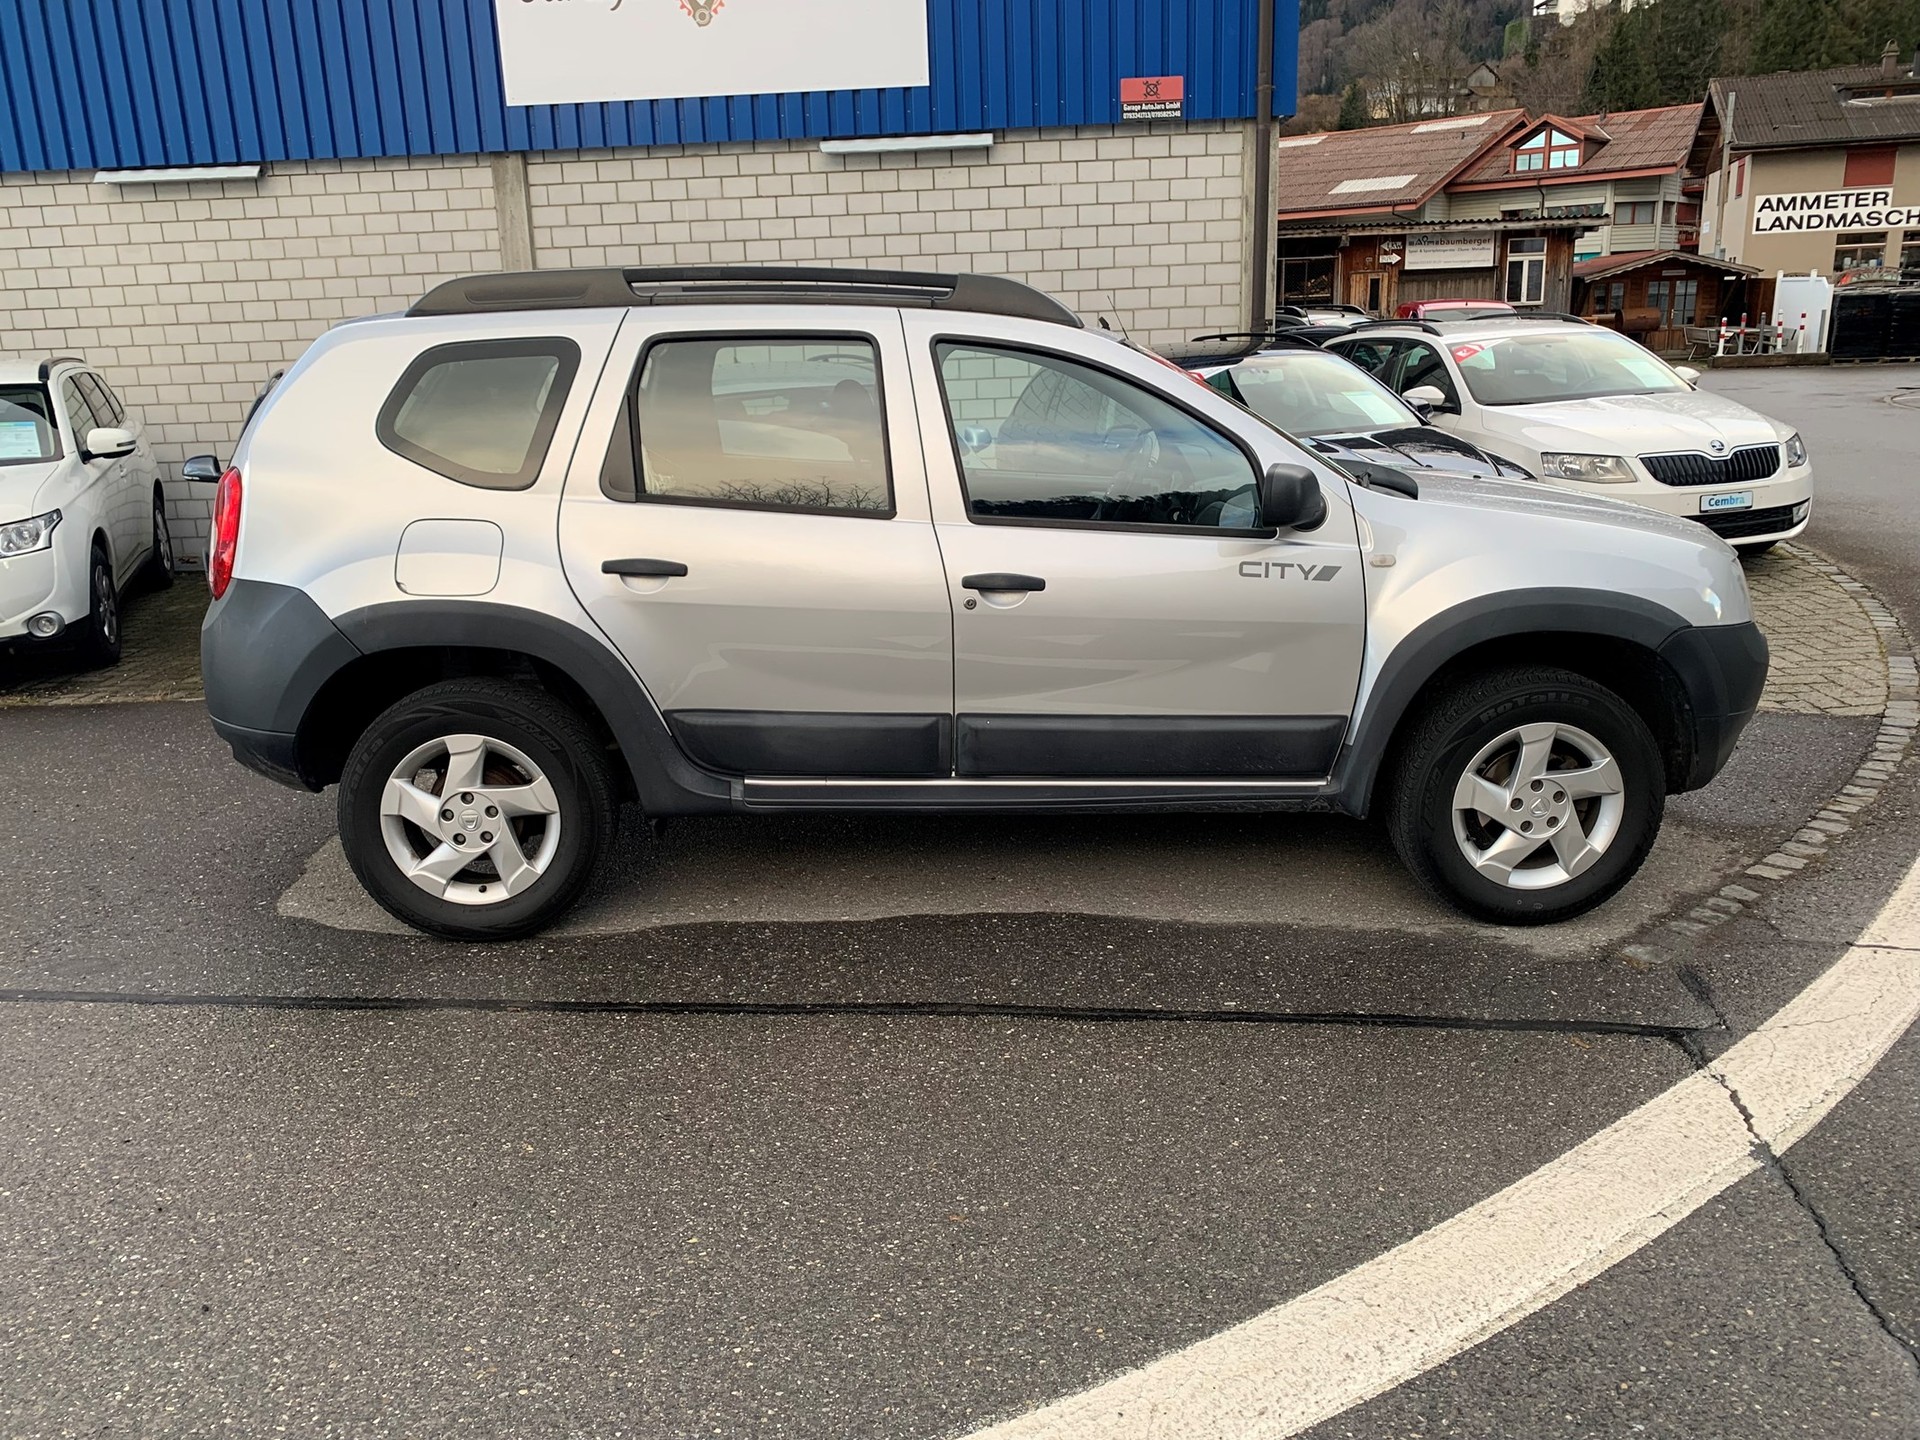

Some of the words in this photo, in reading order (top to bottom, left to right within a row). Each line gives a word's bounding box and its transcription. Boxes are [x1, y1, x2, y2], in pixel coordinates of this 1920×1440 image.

[1757, 191, 1890, 212] AMMETER
[1708, 496, 1745, 507] Cembra
[1238, 560, 1318, 581] CITY
